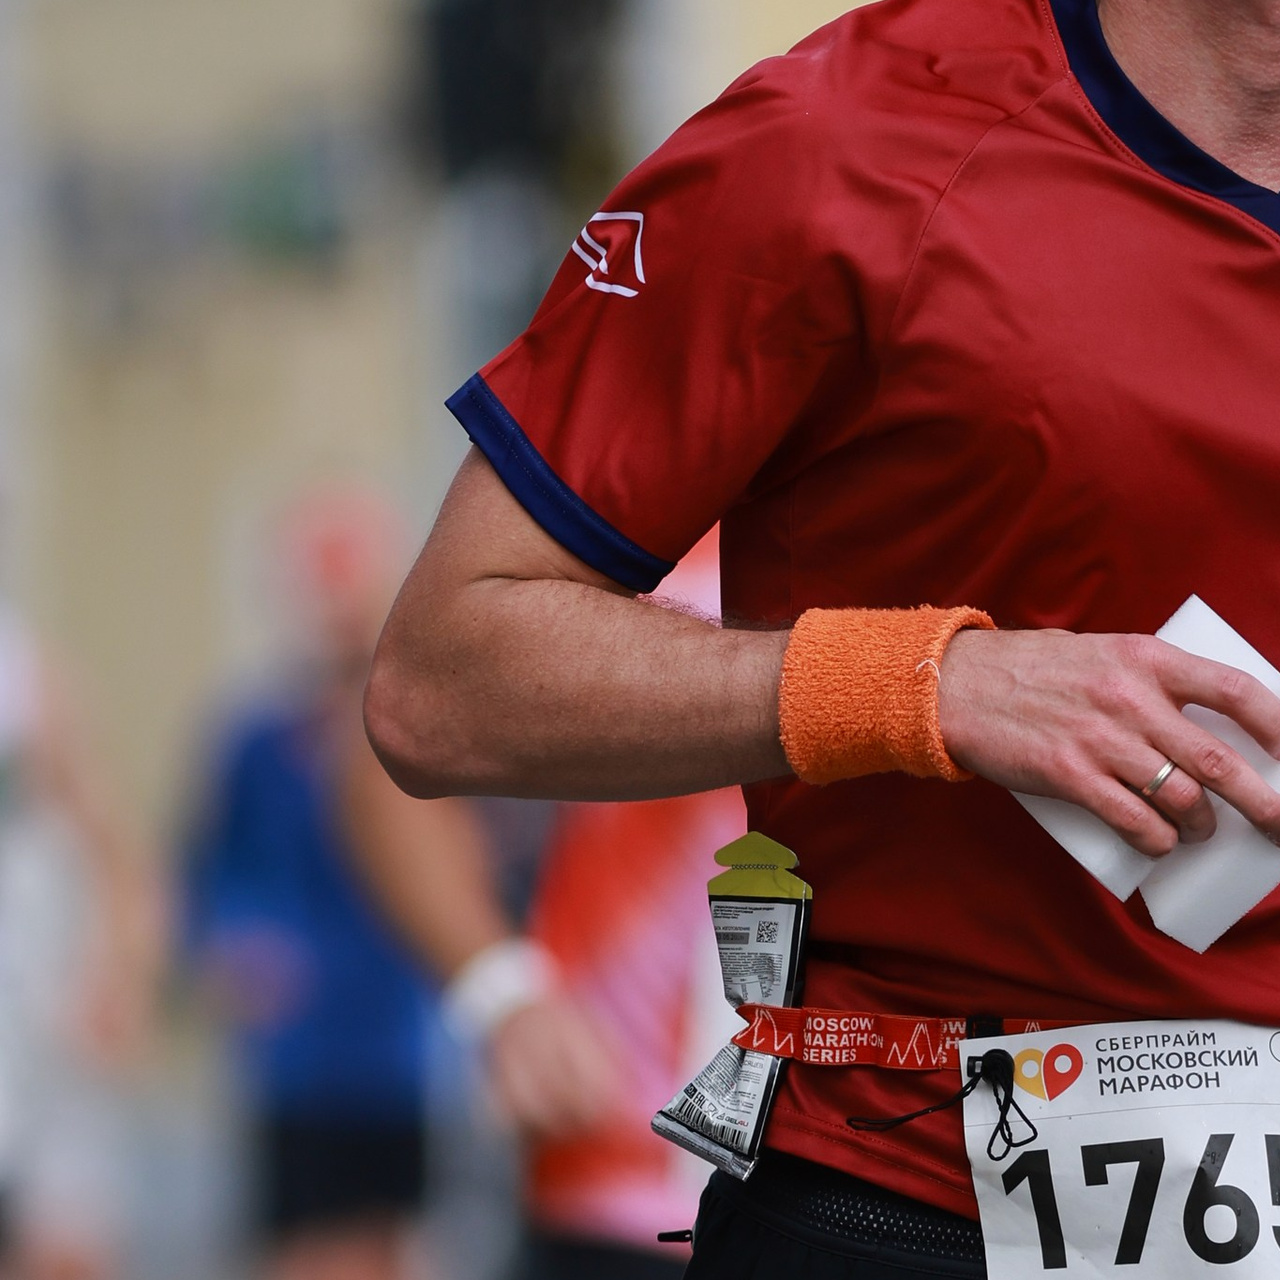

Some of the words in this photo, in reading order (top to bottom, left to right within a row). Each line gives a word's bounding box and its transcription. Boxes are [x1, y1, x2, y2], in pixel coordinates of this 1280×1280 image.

[806, 1017, 874, 1032] MOSCOW
[803, 1032, 884, 1048] MARATHON
[1095, 1030, 1216, 1052] СБЕРПРАЙМ
[803, 1048, 857, 1063] SERIES
[1097, 1046, 1259, 1074] МОСКОВСКИЙ
[1099, 1071, 1221, 1096] МАРАФОН
